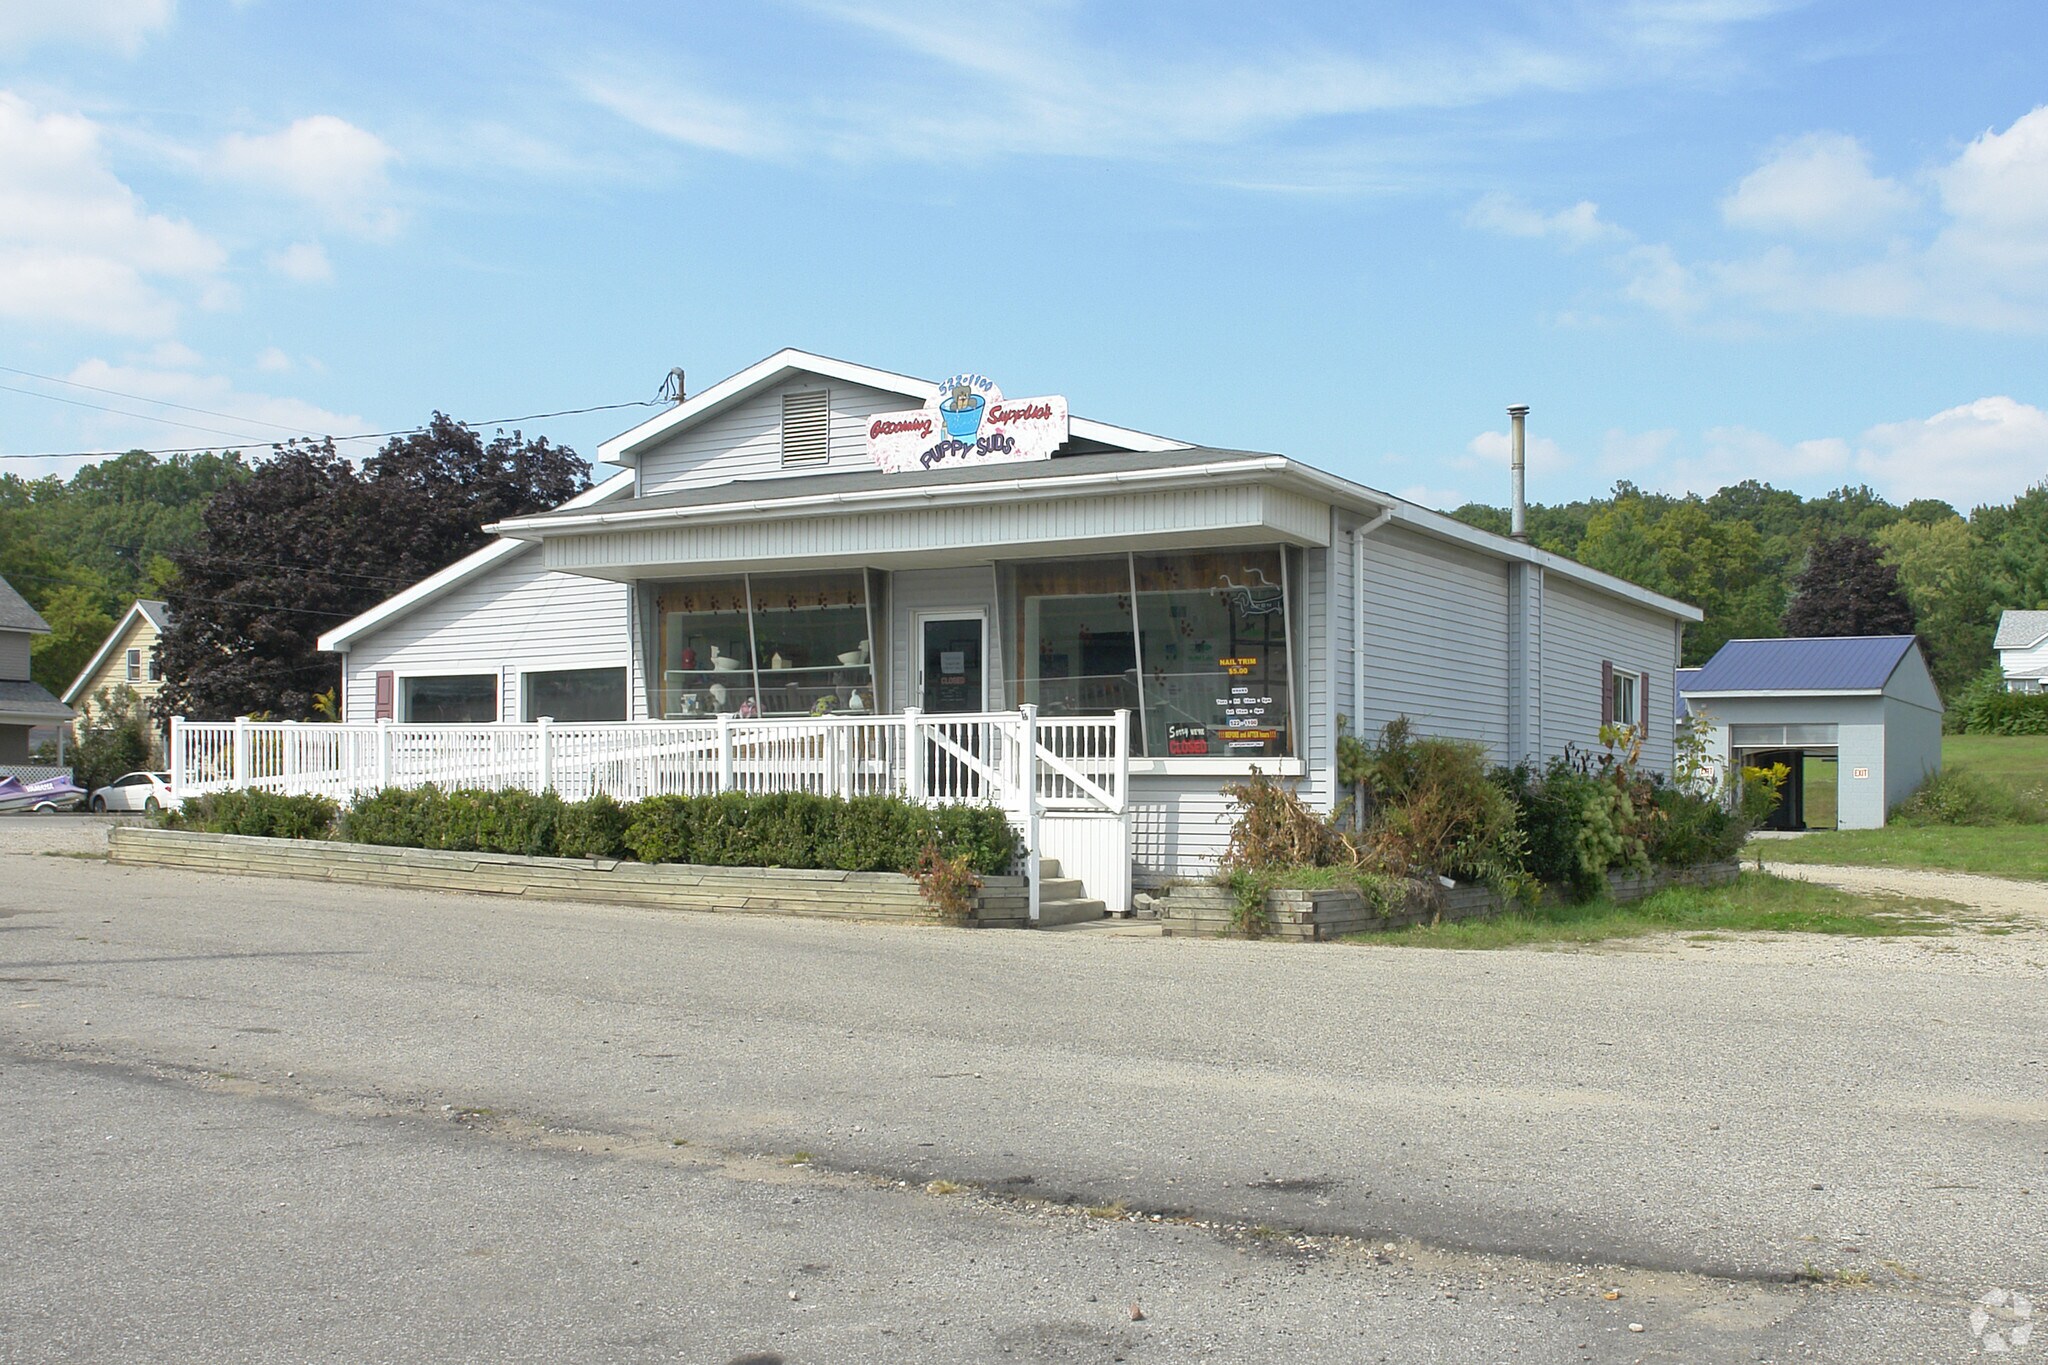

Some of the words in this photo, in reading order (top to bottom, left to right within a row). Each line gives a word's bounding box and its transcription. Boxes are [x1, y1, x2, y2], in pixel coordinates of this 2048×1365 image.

[987, 403, 1052, 426] Supplies
[920, 439, 975, 470] PUPPY
[976, 433, 1015, 456] SUDS
[1238, 657, 1257, 665] TRIM
[1228, 667, 1249, 675] $5.00
[1169, 726, 1188, 738] Sorry
[1169, 740, 1208, 754] CLOSED
